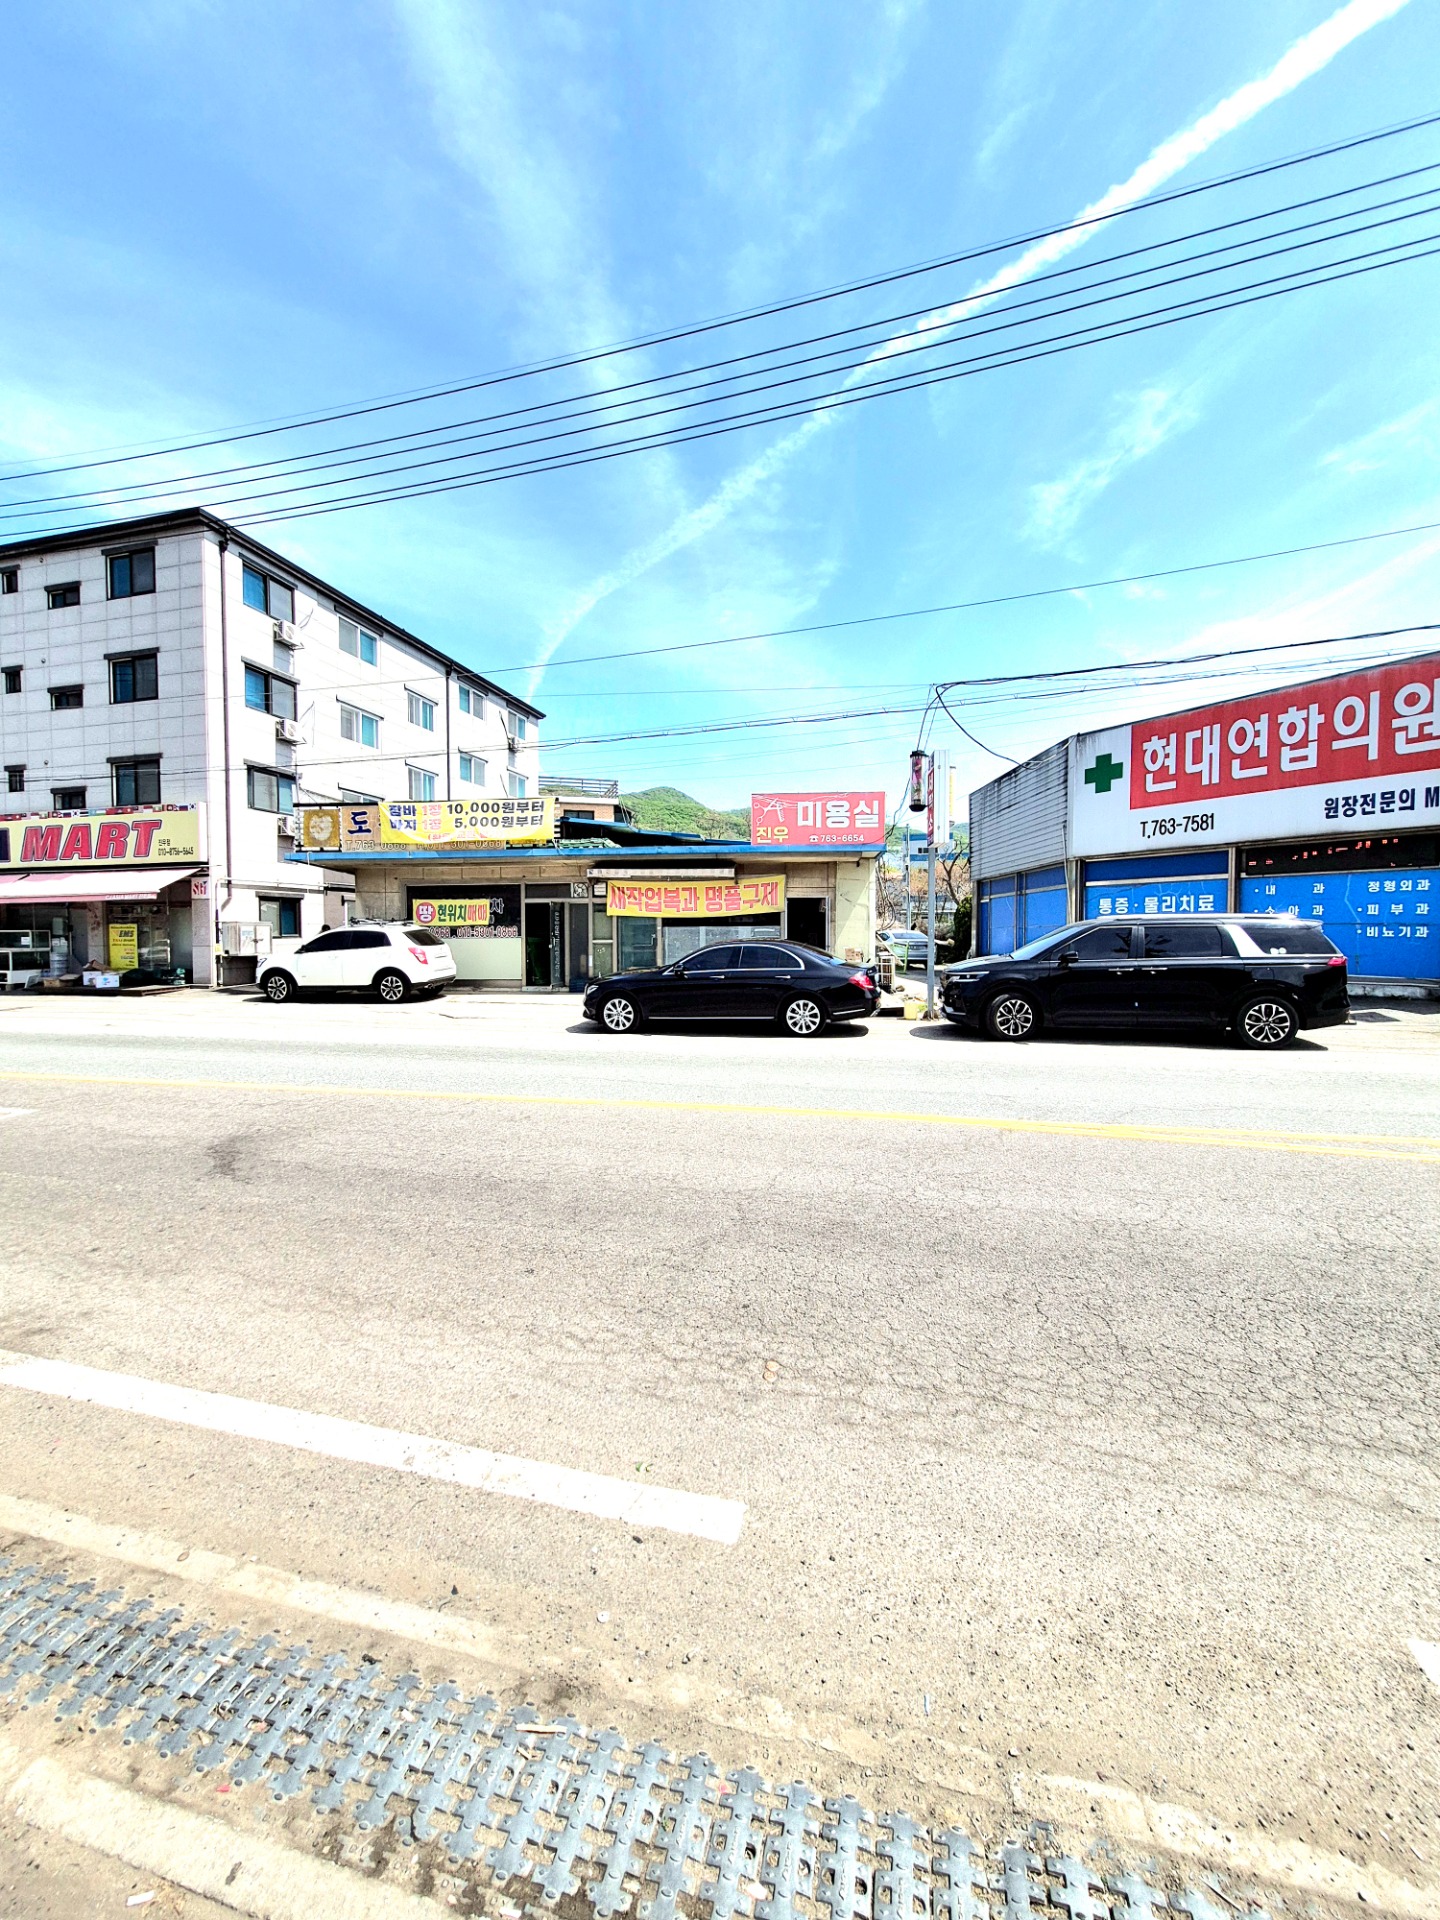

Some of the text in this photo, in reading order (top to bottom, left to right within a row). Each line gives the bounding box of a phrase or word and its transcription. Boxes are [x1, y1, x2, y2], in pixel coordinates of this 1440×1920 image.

[1142, 678, 1440, 793] 현대연합의원
[389, 804, 417, 817] 잠바
[447, 800, 545, 816] 10,000원부터
[1324, 788, 1416, 820] 원장전문의
[390, 818, 417, 832] 바지
[454, 814, 544, 830] 5,000원부터
[797, 800, 880, 829] 미용실
[1139, 812, 1215, 839] T.763-7581
[20, 819, 163, 862] MART
[756, 826, 789, 844] 진우
[820, 834, 865, 843] 763-6654
[1367, 879, 1432, 894] 정형외과
[609, 881, 779, 913] 새작업복과 명품구제
[418, 905, 434, 922] 땅
[1366, 925, 1430, 938] 비뇨기과
